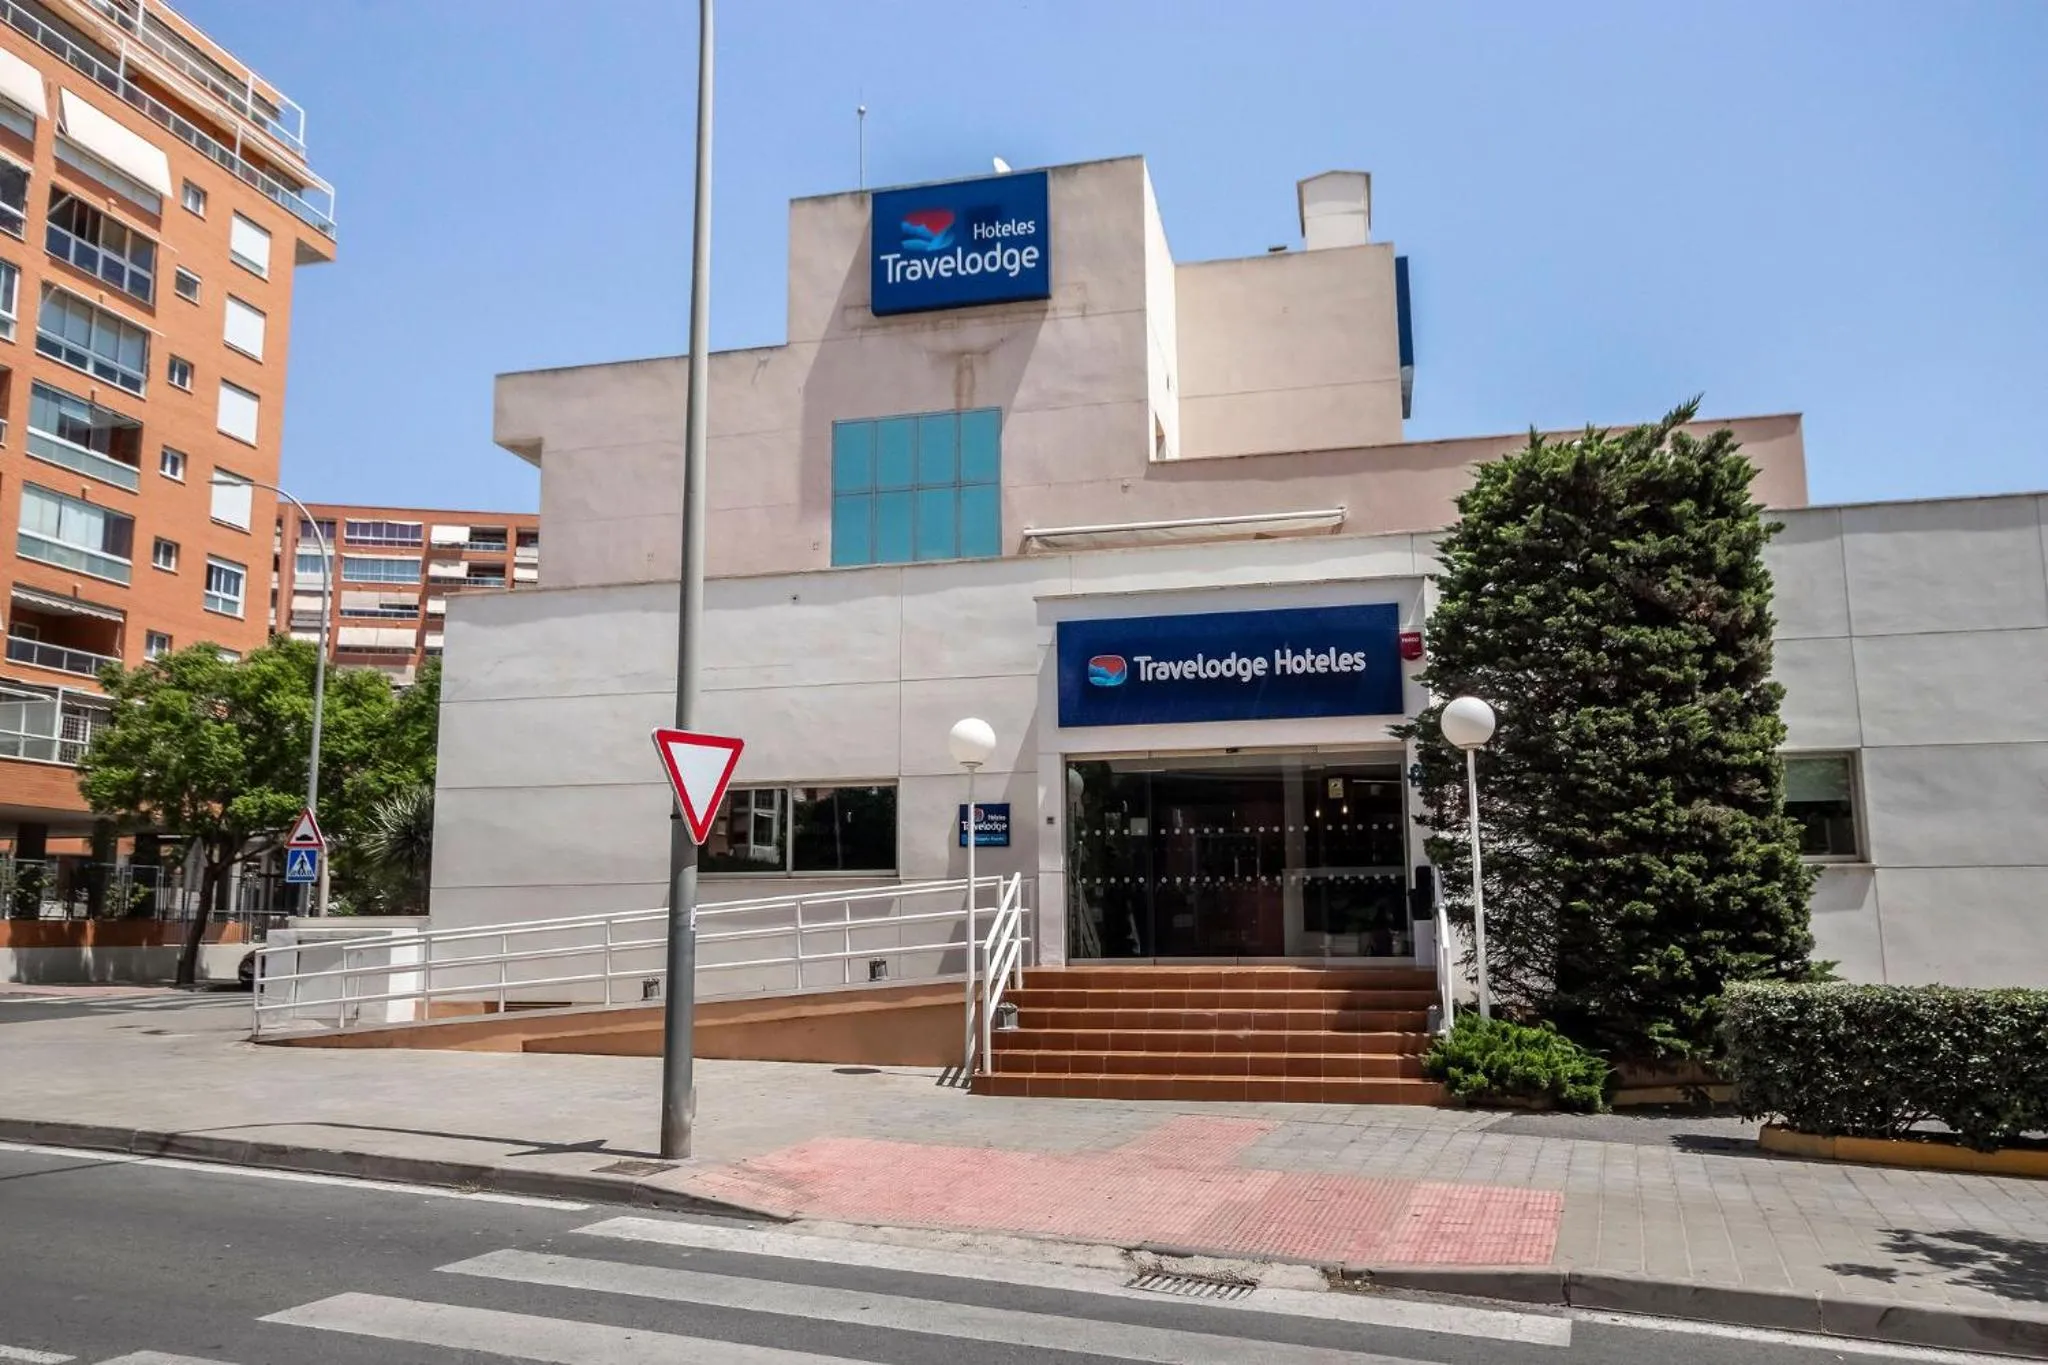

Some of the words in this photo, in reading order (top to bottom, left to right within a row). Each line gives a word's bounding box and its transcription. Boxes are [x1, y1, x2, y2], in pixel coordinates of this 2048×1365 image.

[973, 218, 1036, 240] Hoteles
[879, 241, 1040, 284] Travelodge
[1132, 651, 1269, 683] Travelodge
[1274, 646, 1367, 676] Hoteles
[961, 821, 1008, 832] Tvelodge
